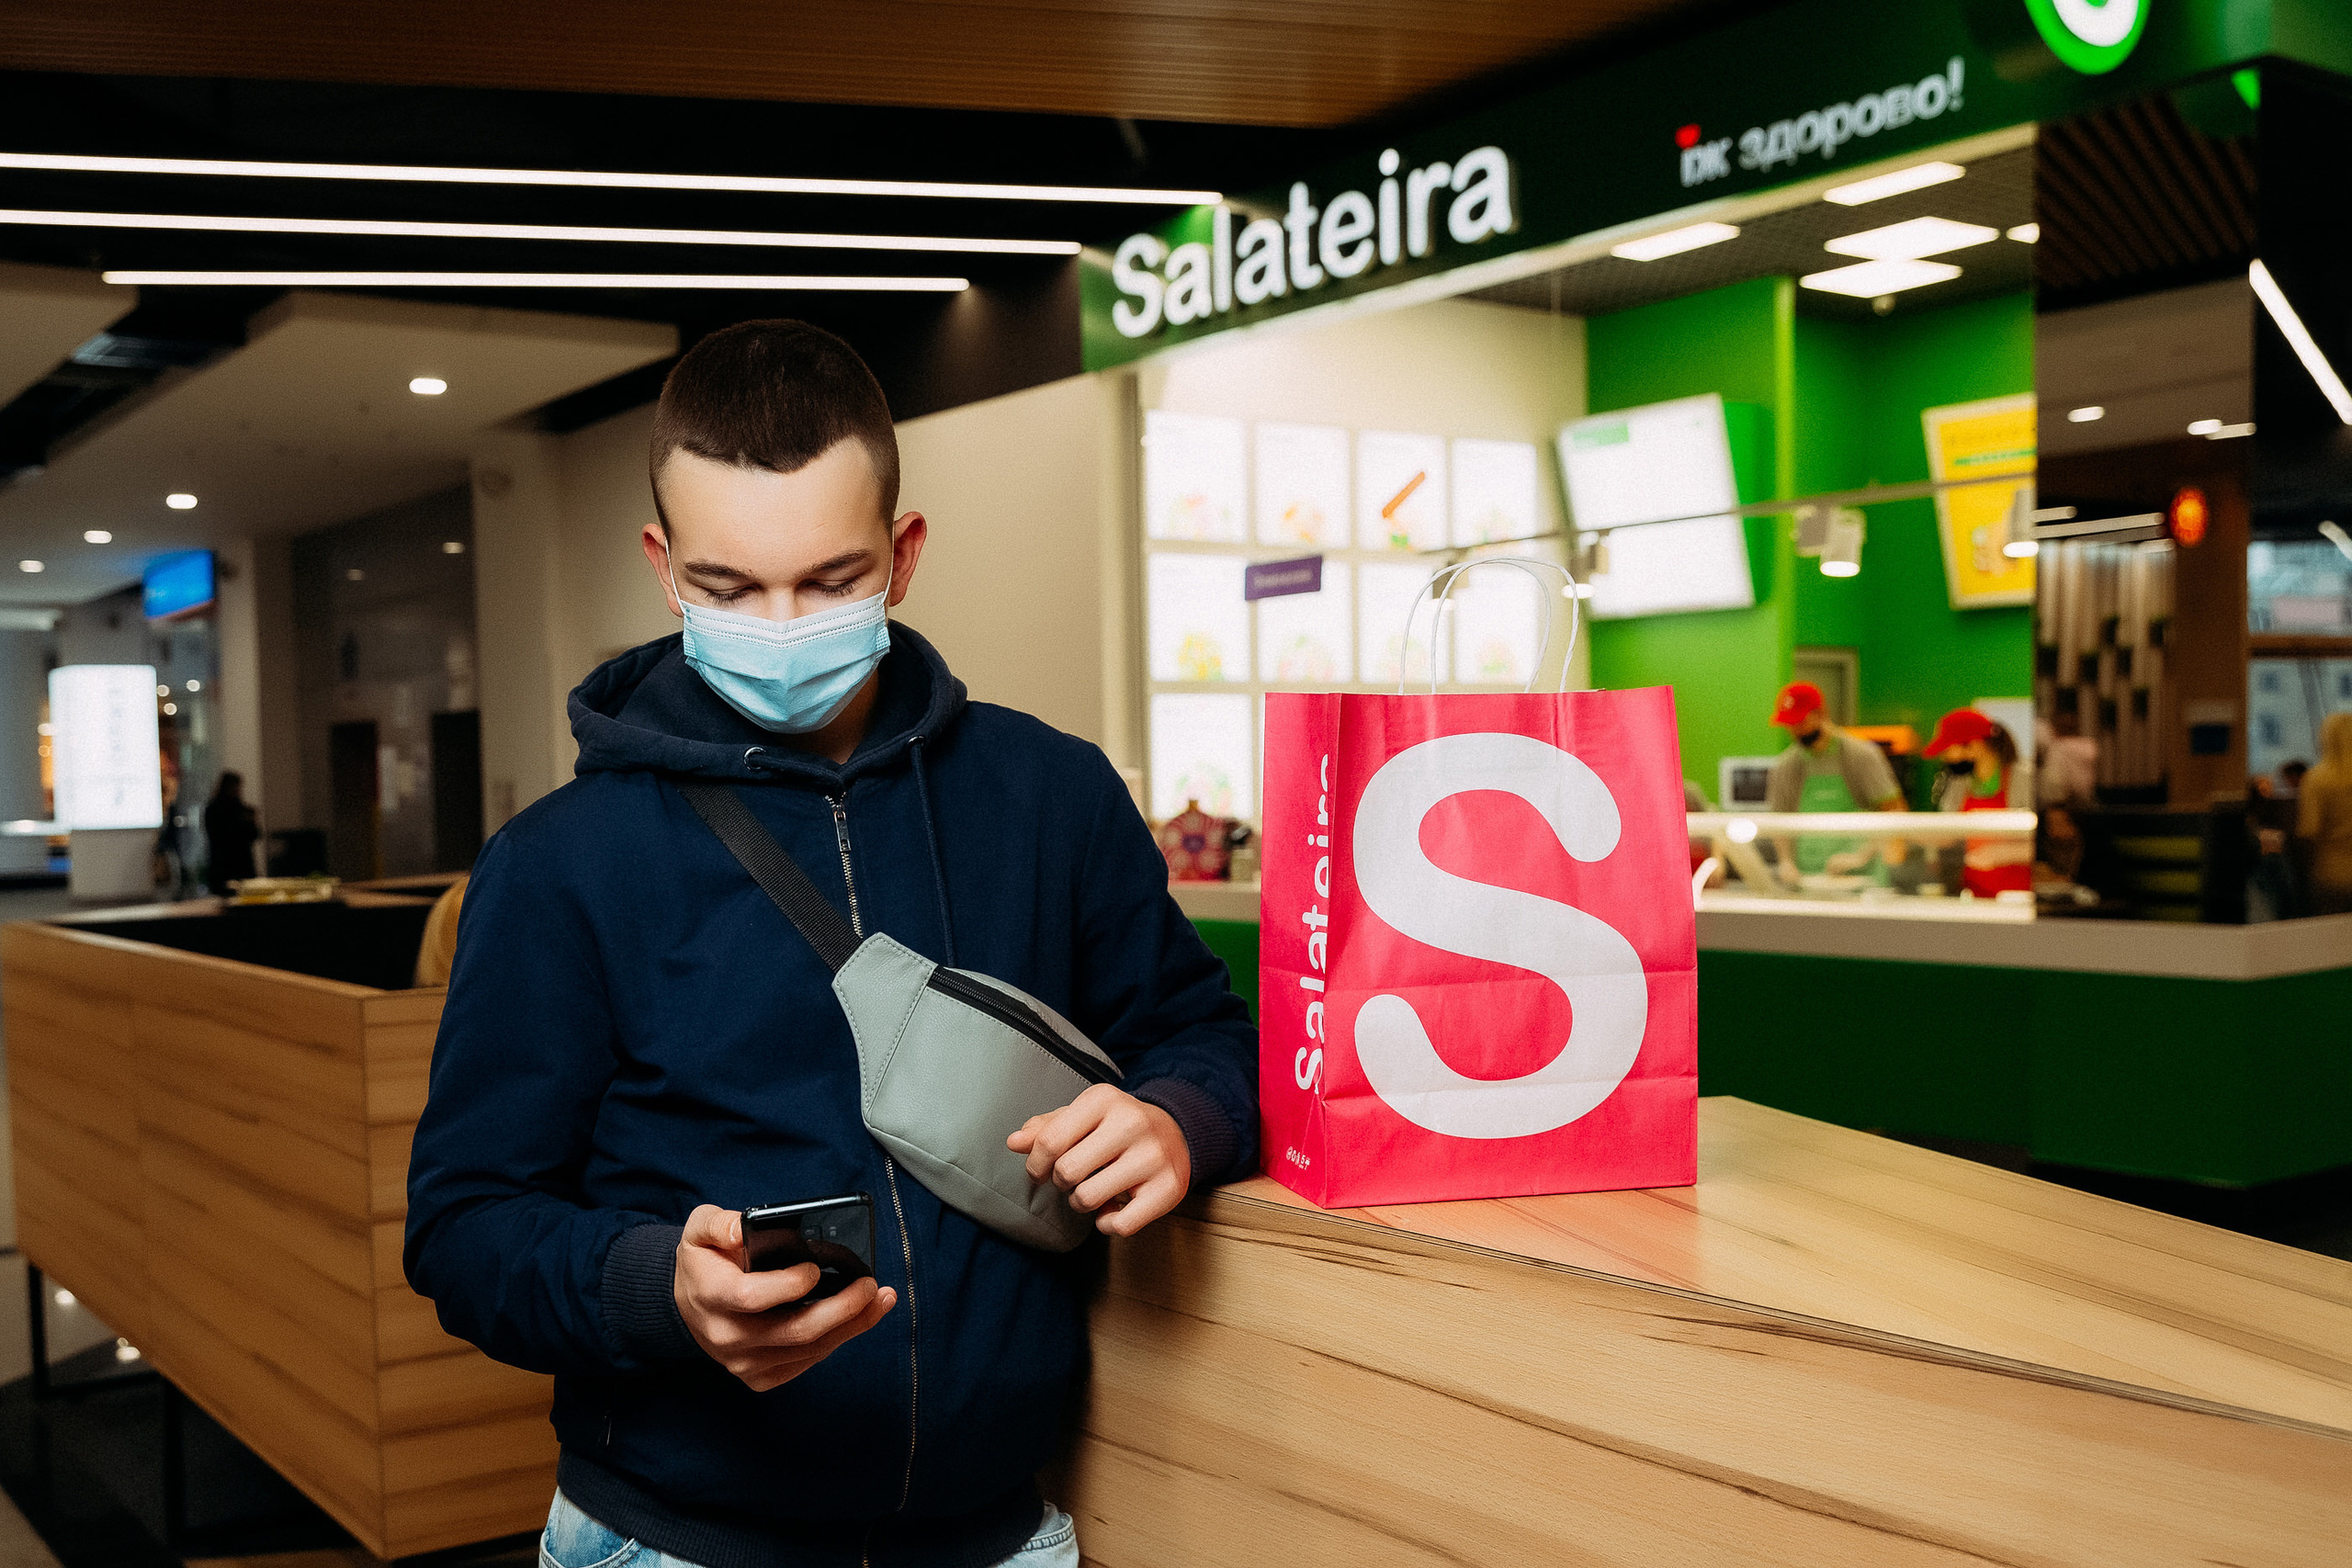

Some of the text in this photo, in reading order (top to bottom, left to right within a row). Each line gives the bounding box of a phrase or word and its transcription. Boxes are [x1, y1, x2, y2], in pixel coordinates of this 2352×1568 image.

[1738, 55, 1966, 173] здорово!
[1112, 145, 1516, 338] Salateira
[1353, 732, 1648, 1139] S
